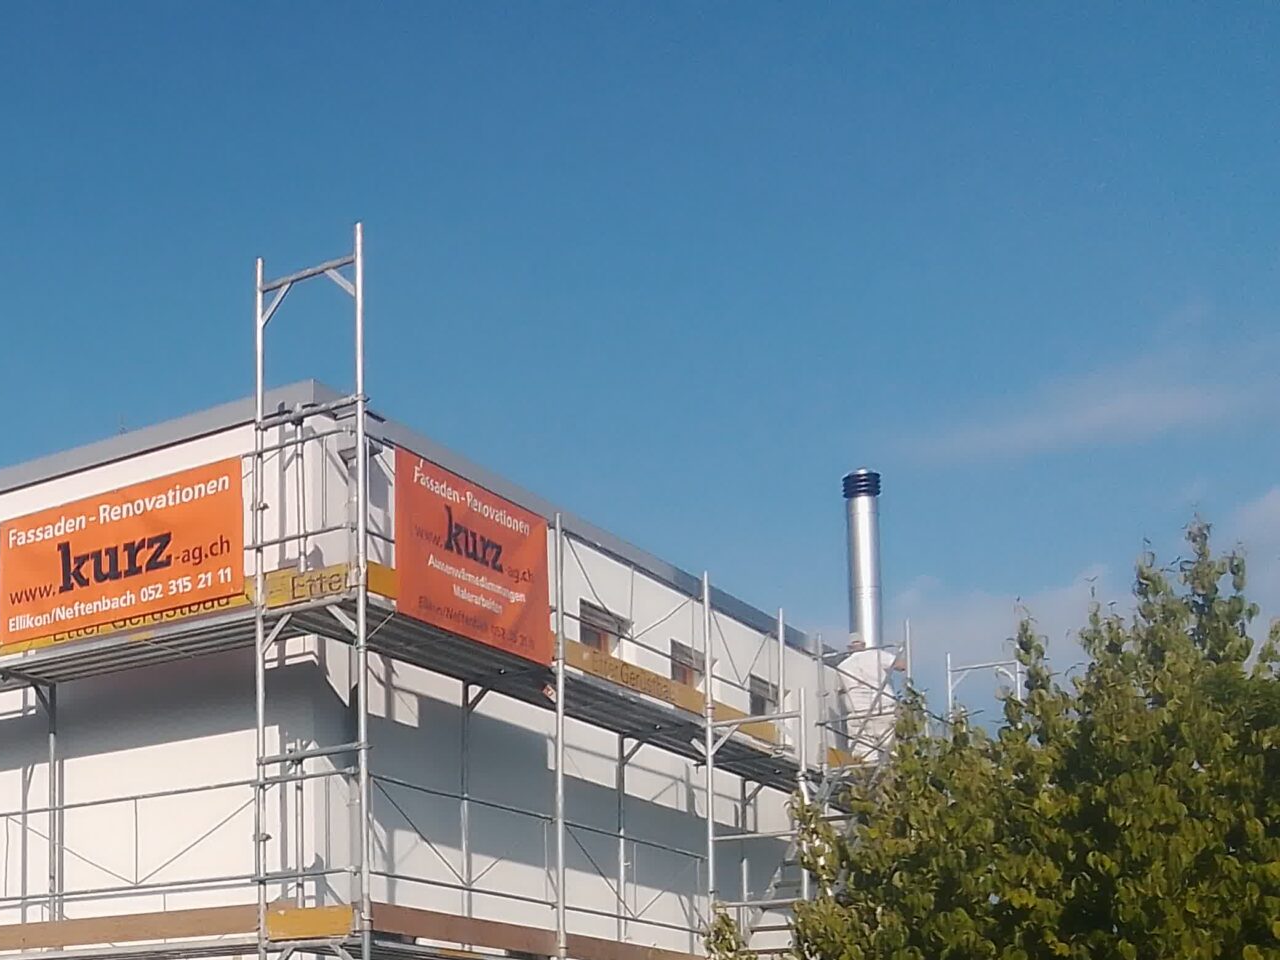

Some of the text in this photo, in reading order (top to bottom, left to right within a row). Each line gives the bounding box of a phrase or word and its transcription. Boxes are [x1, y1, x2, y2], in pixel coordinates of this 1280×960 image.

[8, 591, 136, 633] Ellikon/Neftenbach
[140, 585, 164, 603] 052
[168, 576, 193, 596] 315
[197, 572, 213, 589] 21
[217, 566, 233, 584] 11
